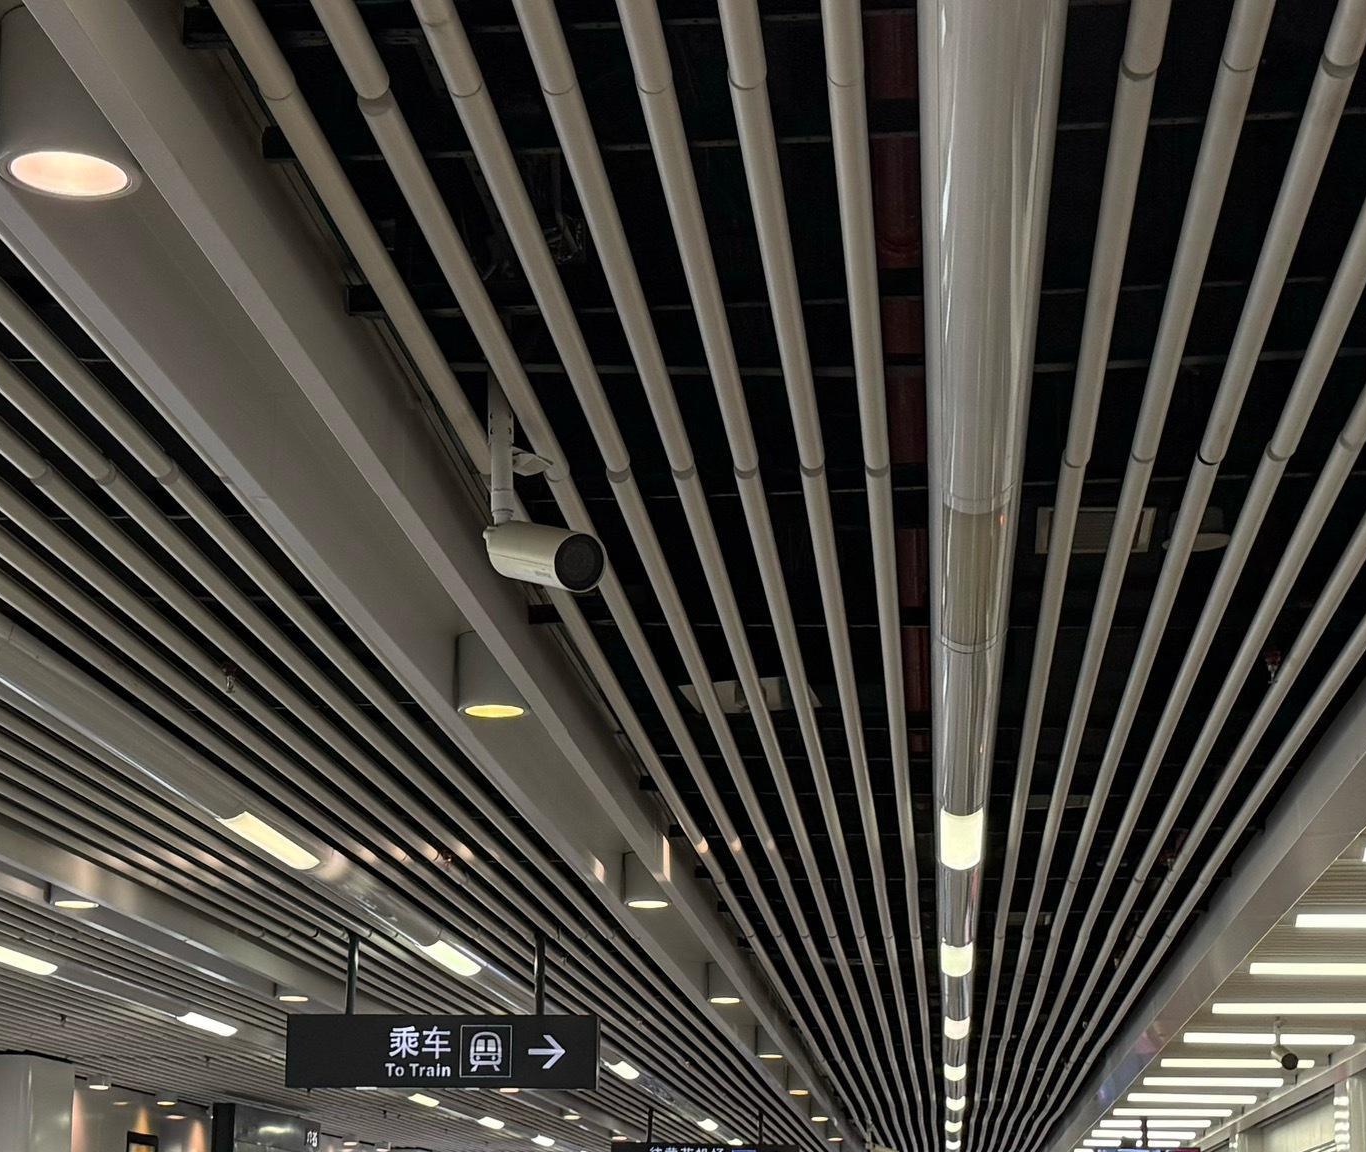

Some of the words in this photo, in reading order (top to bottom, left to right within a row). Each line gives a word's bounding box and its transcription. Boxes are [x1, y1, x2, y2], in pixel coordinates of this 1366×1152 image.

[389, 1026, 451, 1059] 乘车
[385, 1063, 404, 1077] To
[409, 1063, 451, 1077] Train
